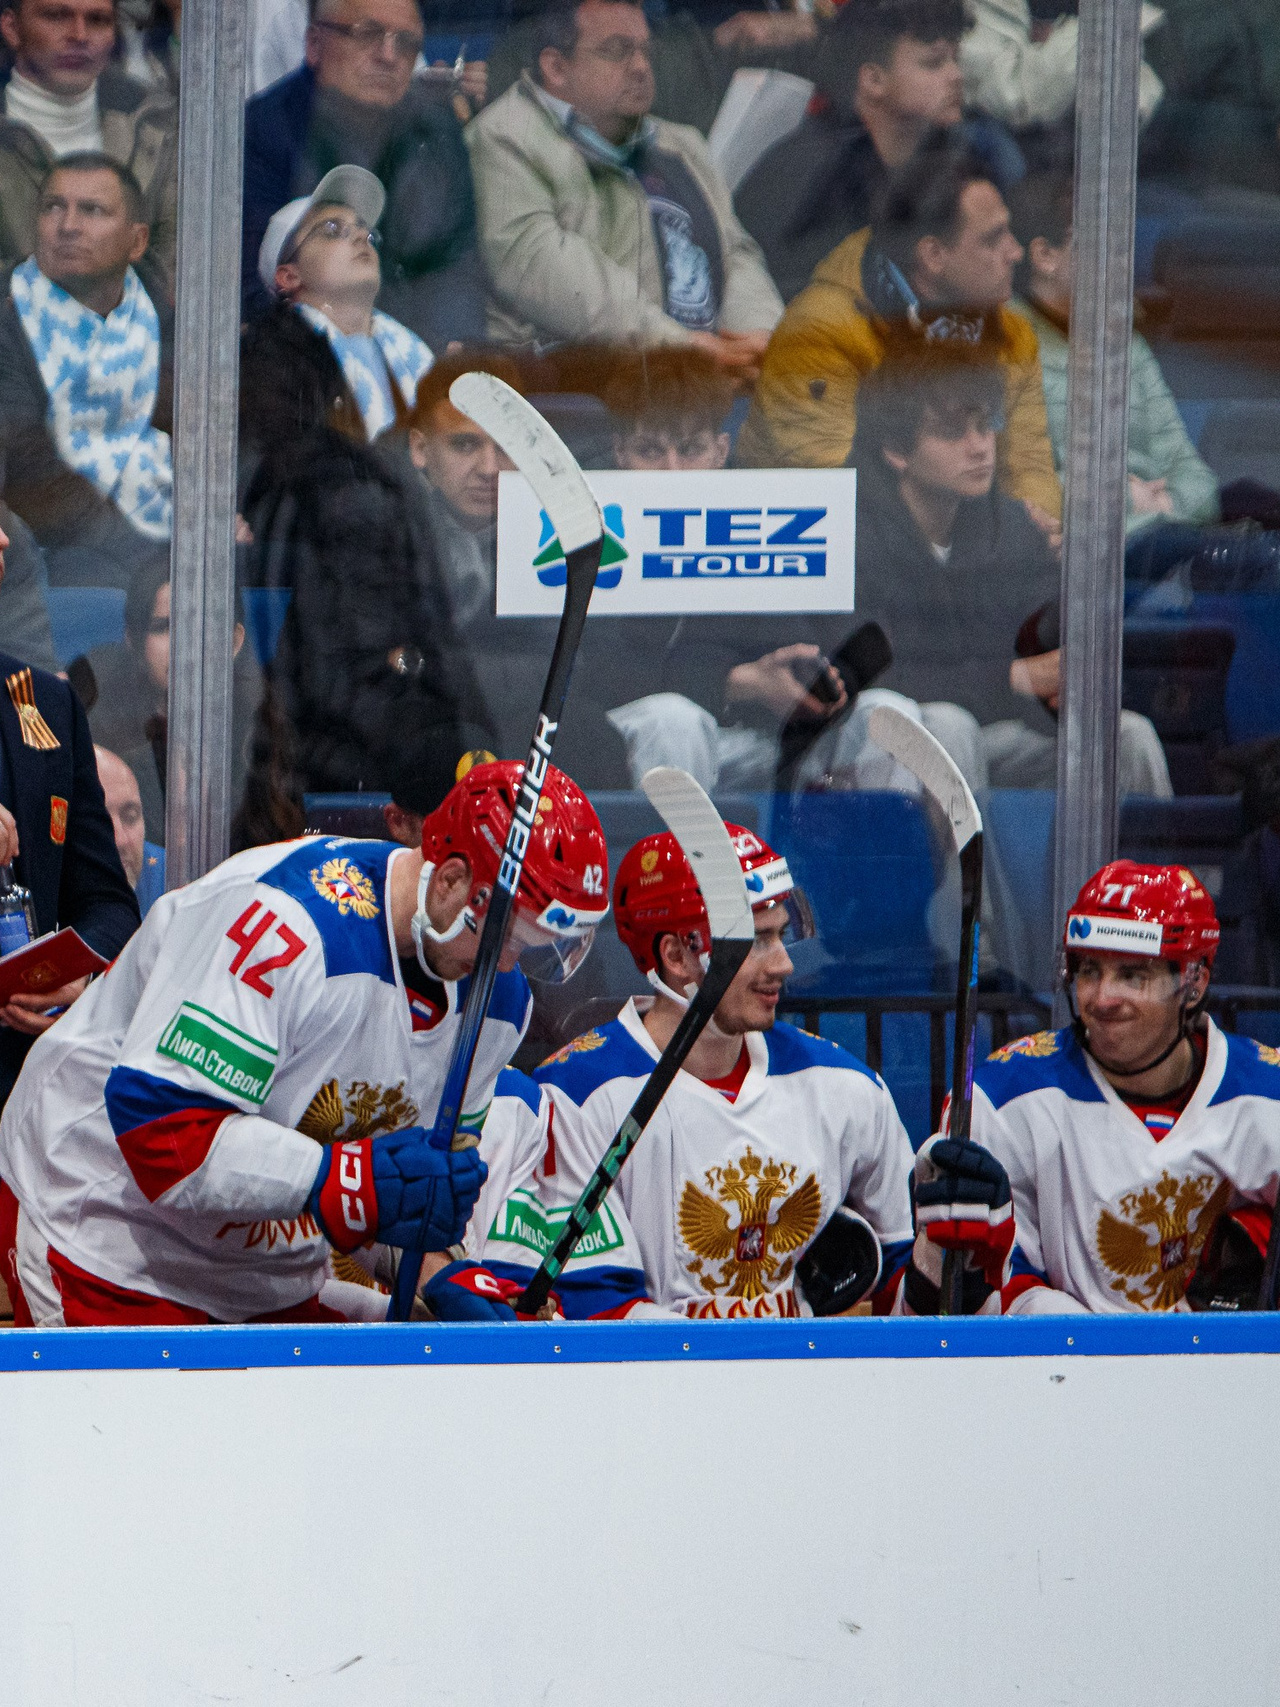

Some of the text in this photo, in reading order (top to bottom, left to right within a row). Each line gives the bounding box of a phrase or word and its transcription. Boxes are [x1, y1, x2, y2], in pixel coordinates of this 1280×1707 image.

[642, 508, 827, 546] TEZ
[660, 554, 809, 577] TOUR
[583, 864, 603, 895] 42
[1101, 883, 1138, 908] 71
[225, 899, 308, 999] 42
